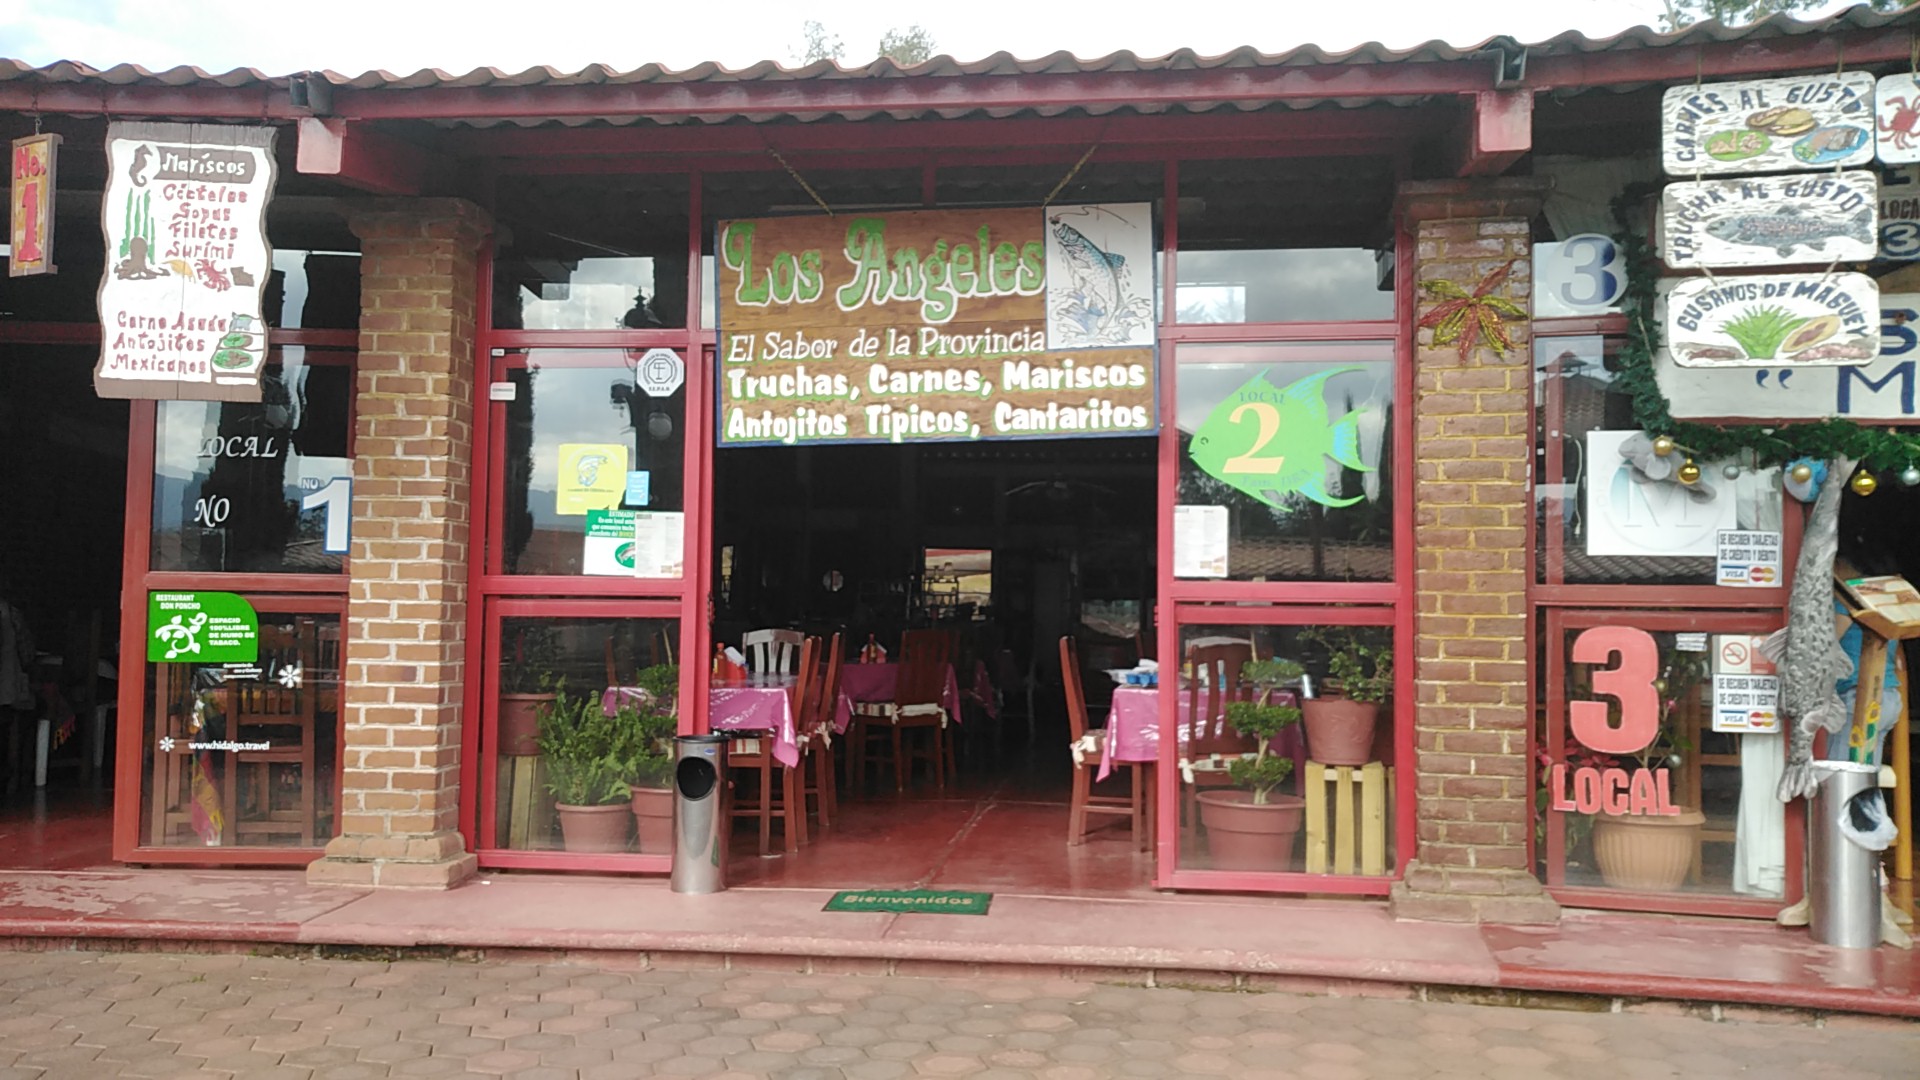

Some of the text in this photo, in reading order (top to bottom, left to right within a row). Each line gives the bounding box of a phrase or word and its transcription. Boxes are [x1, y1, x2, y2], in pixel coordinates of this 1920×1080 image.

[1675, 82, 1862, 162] CARNES AL GUSTO
[16, 145, 46, 179] No.
[18, 182, 42, 262] 1
[172, 202, 231, 224] Sopas
[1674, 181, 1864, 261] TRUCHA AL GUSTO
[168, 221, 238, 240] Filetes
[722, 218, 1046, 323] Los Angeles
[1561, 237, 1618, 306] 3
[118, 310, 167, 329] Carne
[1677, 281, 1870, 338] GUSANOS DE MAGUEY
[112, 332, 205, 352] Antojitos
[727, 326, 1046, 363] El Sabor de la Provincia
[110, 354, 206, 375] Mexicanos
[727, 358, 1147, 402] Truchas, Carnes, Mariscos
[1239, 391, 1286, 405] LOCAL
[727, 406, 849, 445] Antojitos
[994, 397, 1148, 431] Cantaritos
[196, 436, 279, 458] LOCAL
[1222, 402, 1285, 475] 2
[302, 478, 320, 490] NO
[194, 494, 231, 528] NO
[302, 477, 353, 554] 1
[1720, 533, 1778, 547] SE RECIBEN TARJETAS
[1721, 549, 1728, 561] DE
[1725, 570, 1745, 578] VISA
[1569, 625, 1660, 755] 3
[1718, 677, 1777, 691] SE RECIBEN TARJETAS
[1719, 692, 1726, 705] DE
[188, 740, 271, 753] www.hidalgo.travel
[1553, 763, 1681, 817] LOCAL
[843, 894, 974, 905] Bienvenidos
